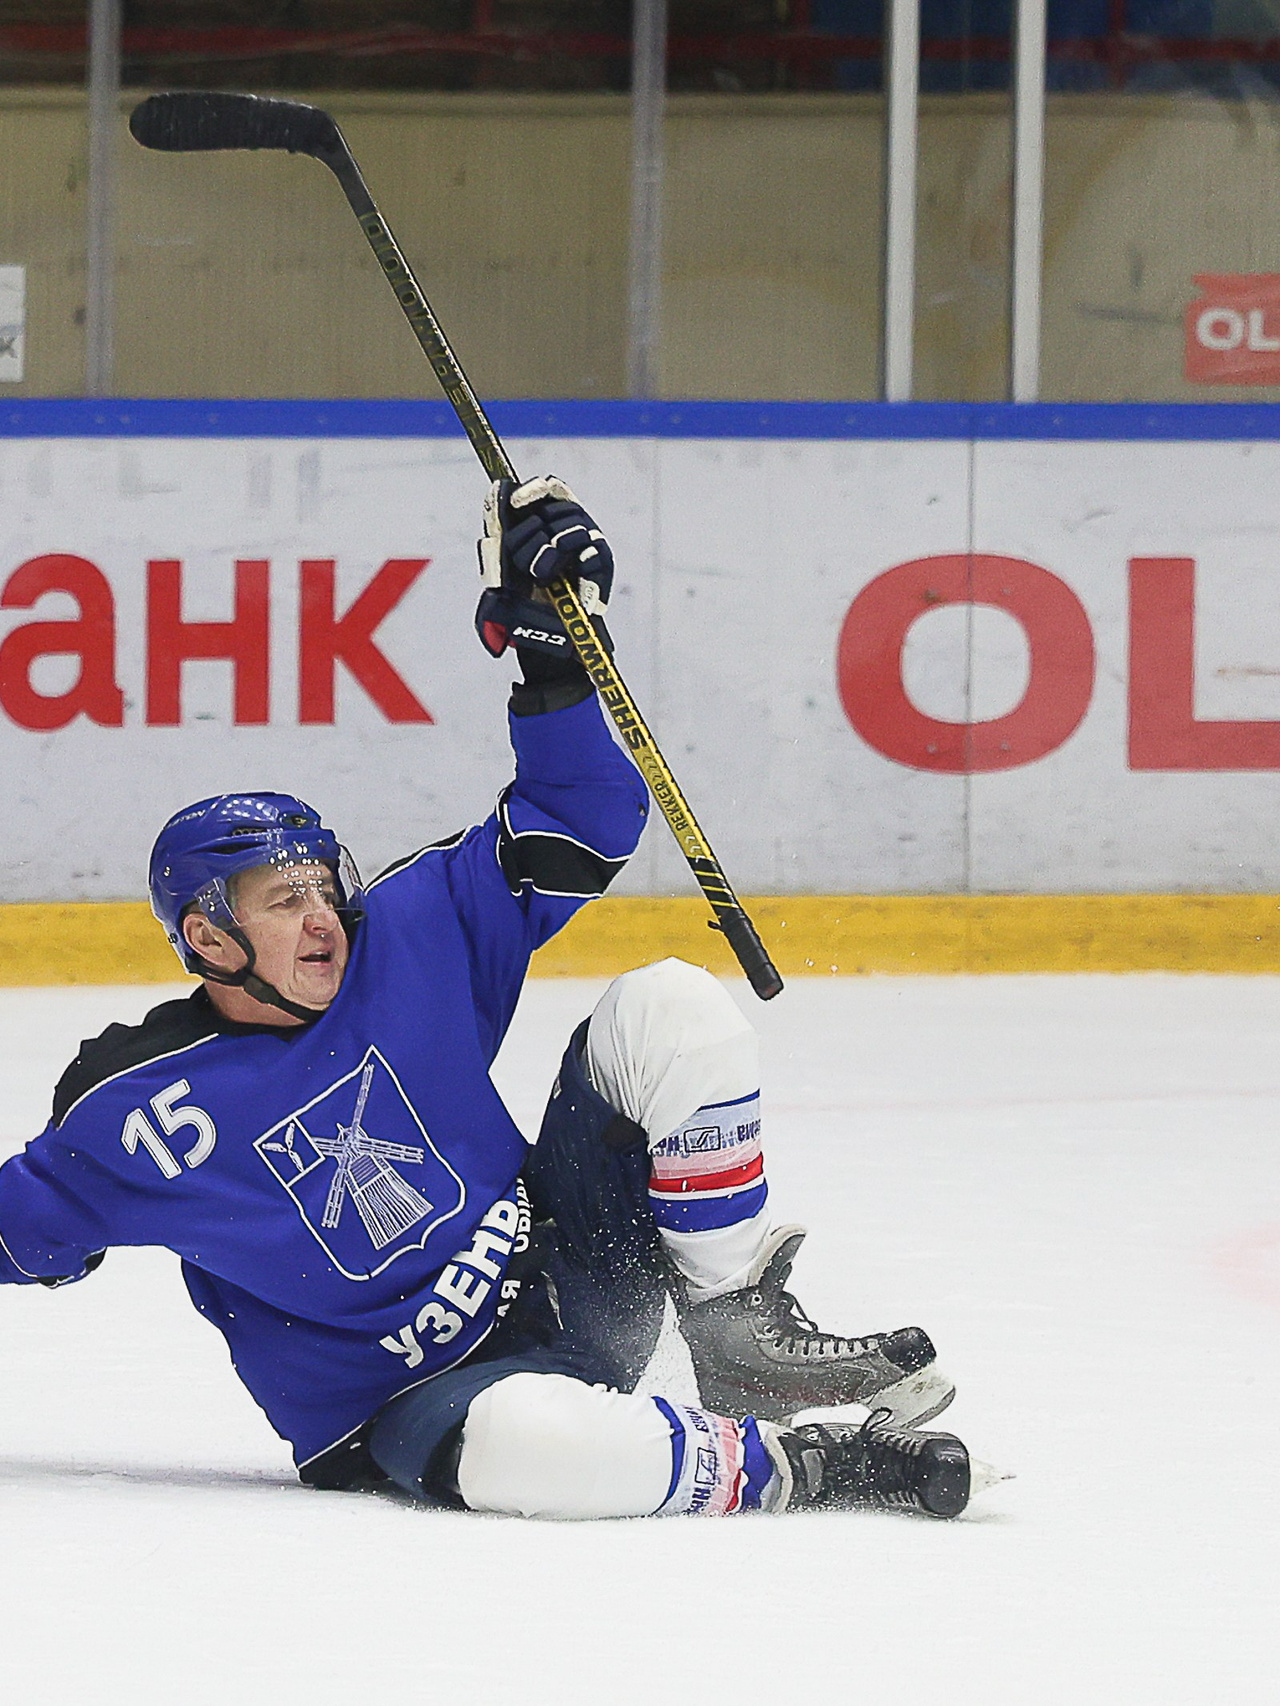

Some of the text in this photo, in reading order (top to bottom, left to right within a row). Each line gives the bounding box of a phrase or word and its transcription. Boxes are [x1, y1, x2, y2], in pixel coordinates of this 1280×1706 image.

[1196, 307, 1280, 351] OL
[513, 626, 567, 646] CCM
[549, 578, 648, 750] SHERWOOD
[837, 553, 1280, 774] OL
[654, 783, 689, 832] REKKER
[121, 1078, 217, 1180] 15
[379, 1200, 520, 1369] УЗЕНЬ
